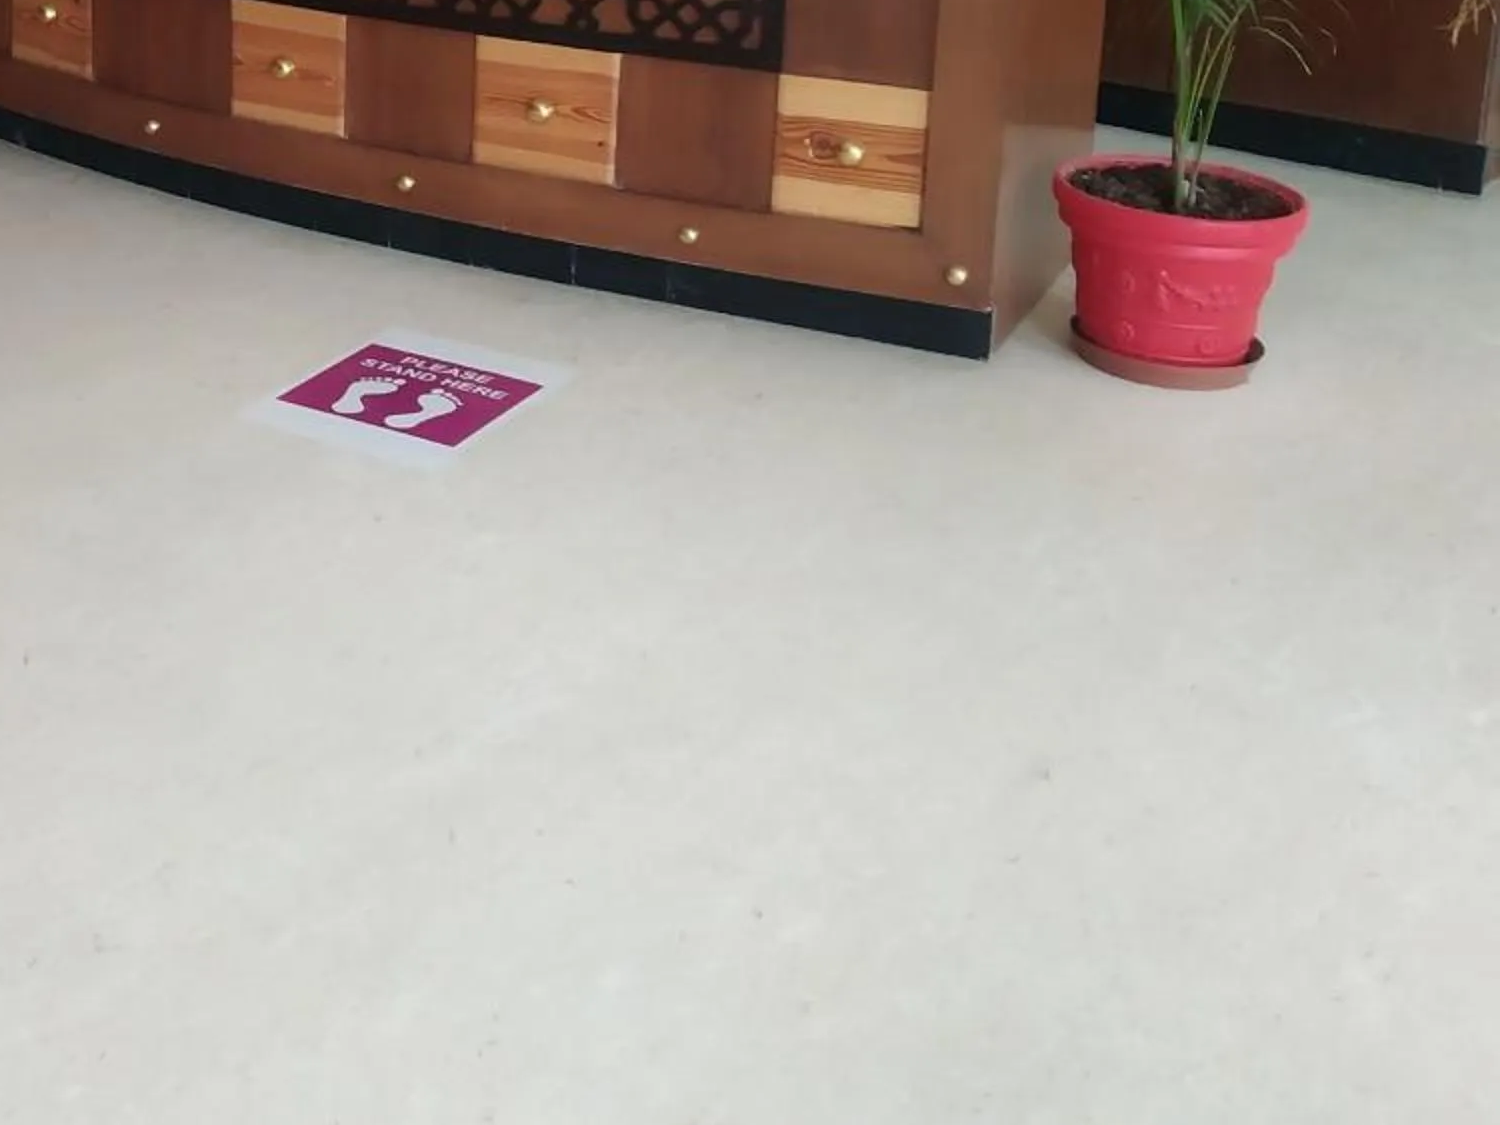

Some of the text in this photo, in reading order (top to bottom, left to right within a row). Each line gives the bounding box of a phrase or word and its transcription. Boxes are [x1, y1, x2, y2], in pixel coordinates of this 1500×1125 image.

[360, 358, 509, 400] STAND HERE
[401, 356, 495, 384] PLEASE
